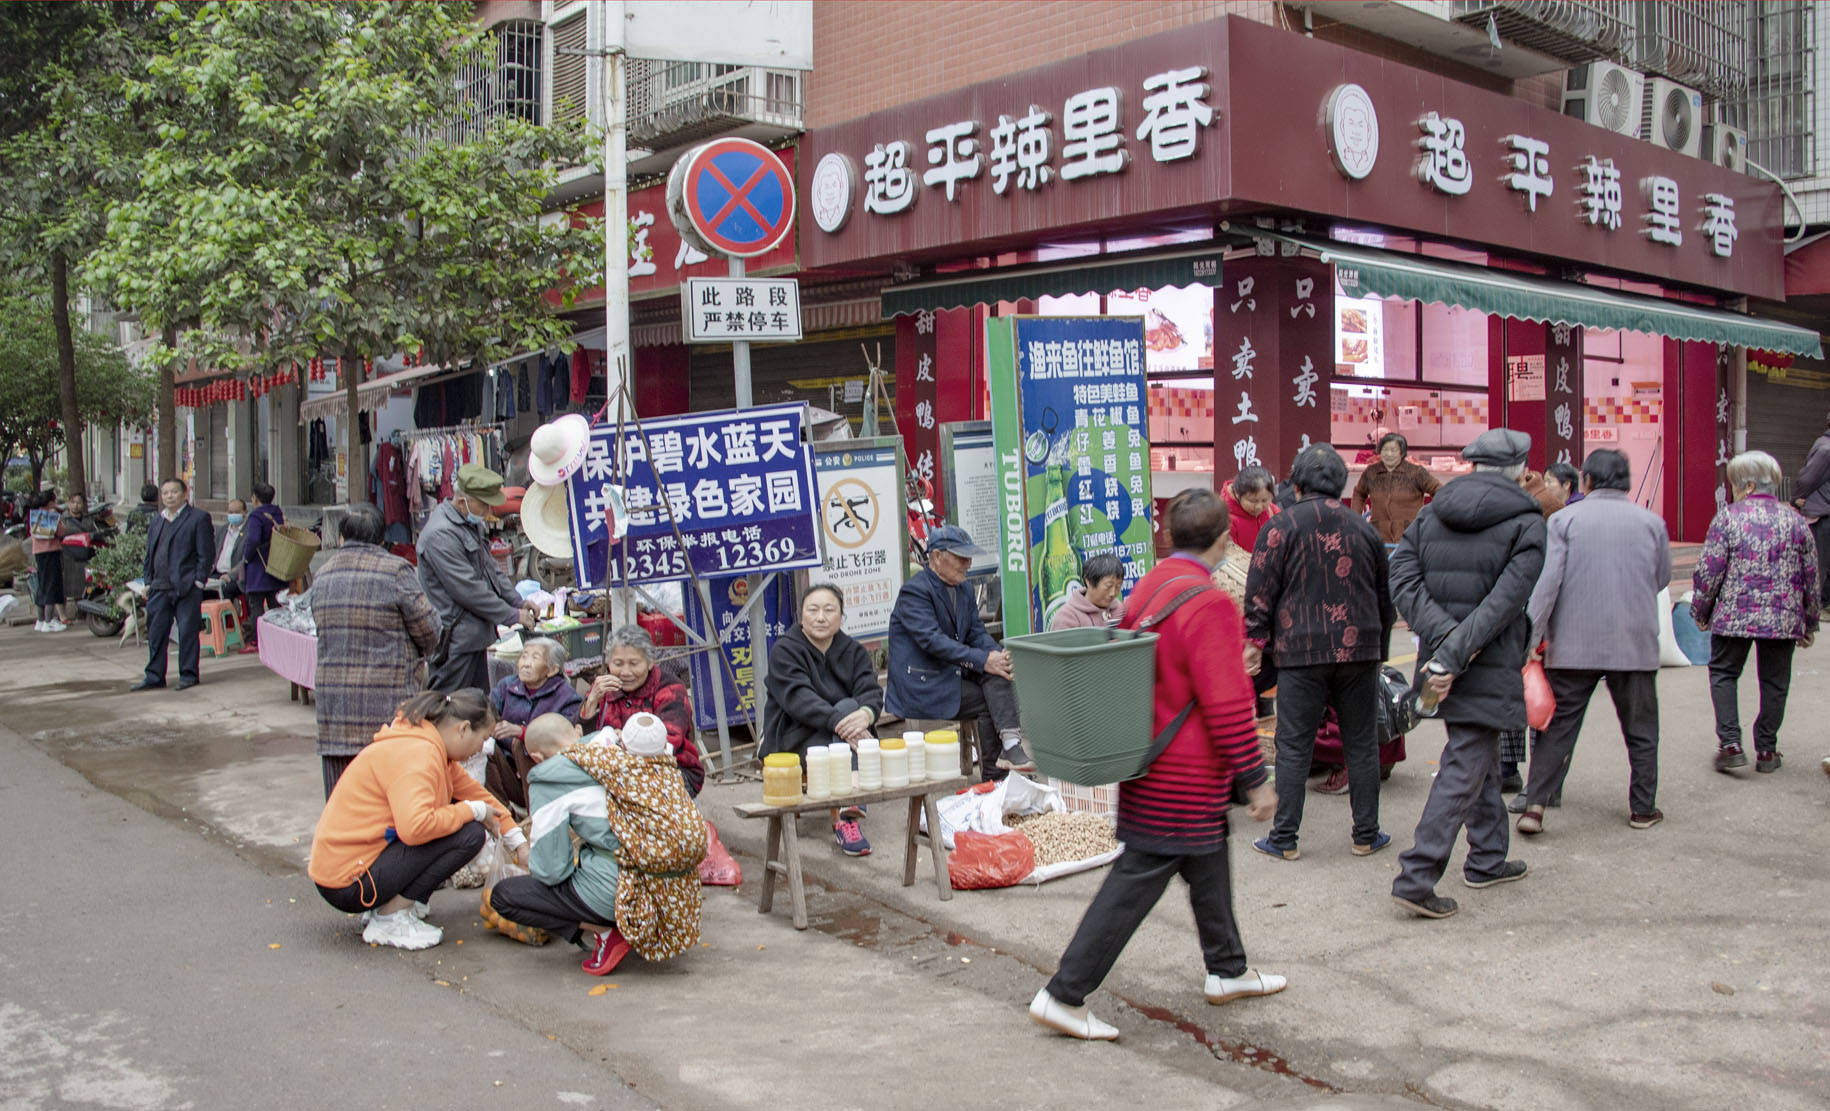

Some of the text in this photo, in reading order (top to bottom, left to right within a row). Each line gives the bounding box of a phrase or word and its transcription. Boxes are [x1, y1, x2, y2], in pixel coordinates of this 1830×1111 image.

[864, 65, 1213, 215] 超平辣里香
[1414, 111, 1738, 257] 超平辣里香
[702, 286, 788, 307] 此路段
[703, 311, 789, 332] 严禁停车
[583, 419, 796, 483] 保护碧水蓝天
[825, 454, 874, 466] 公安 POLICE
[584, 469, 802, 533] 共建绿色家园
[1002, 448, 1026, 573] TUBORG
[636, 526, 762, 555] 环保举报电话
[610, 537, 795, 582] 12345 12369
[823, 549, 887, 572] 禁止飞行器
[829, 572, 839, 580] NO
[841, 569, 862, 578] DRONE
